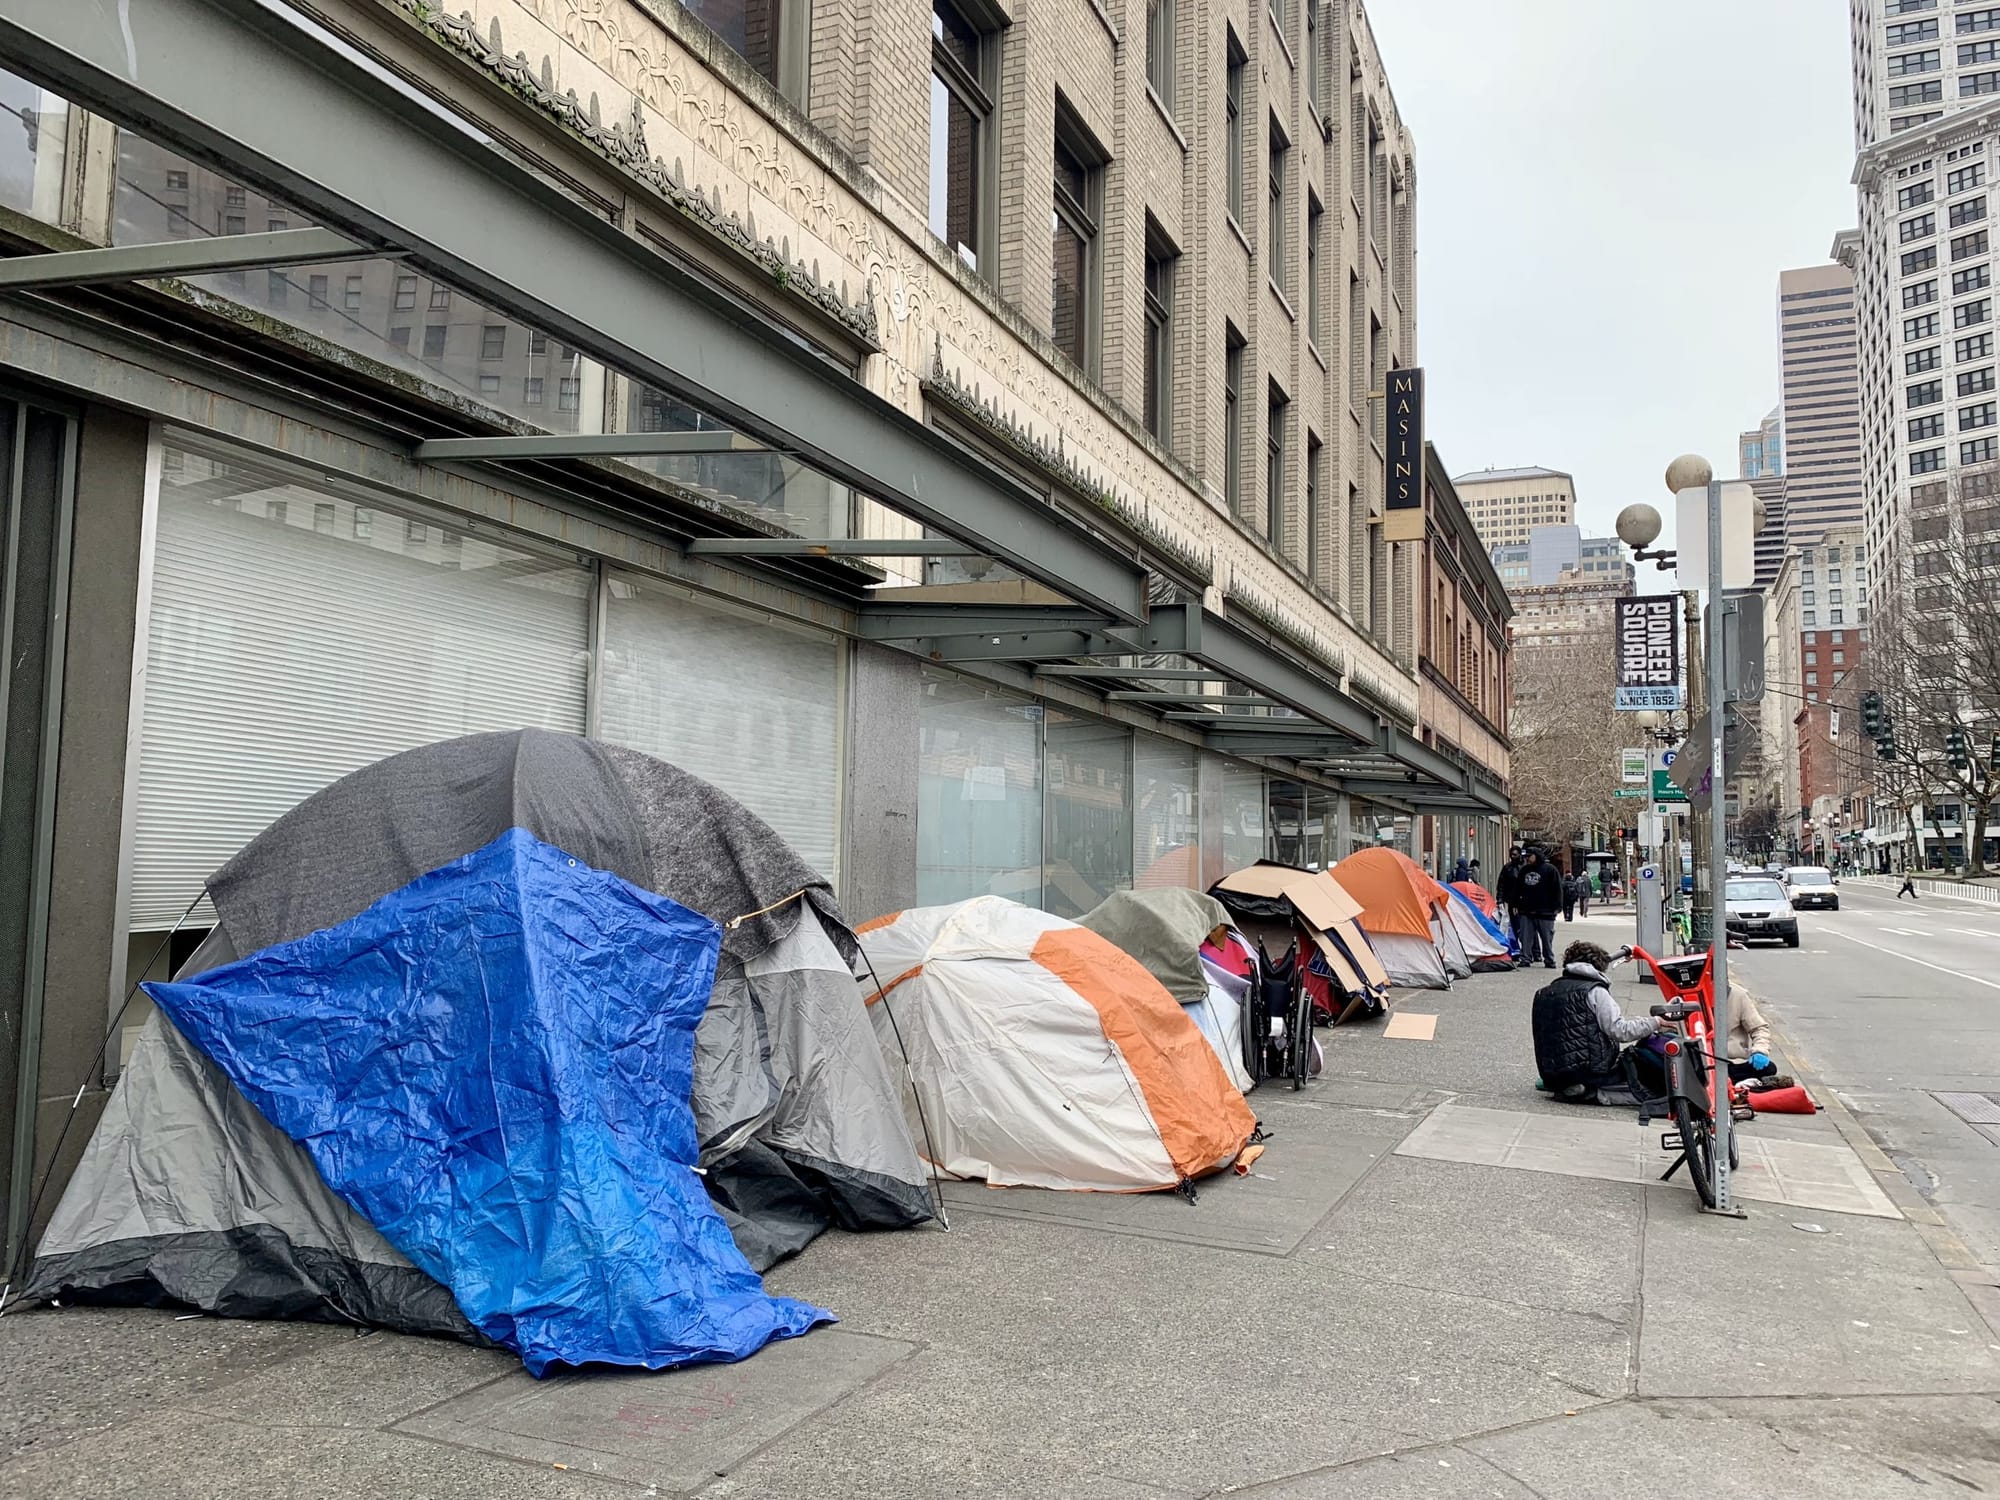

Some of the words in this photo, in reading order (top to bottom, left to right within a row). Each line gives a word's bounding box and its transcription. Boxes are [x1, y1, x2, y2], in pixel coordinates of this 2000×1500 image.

[1394, 377, 1413, 499] MASINS
[1623, 603, 1647, 682] SQUARE
[1647, 602, 1671, 682] PIONEER
[1651, 695, 1675, 706] 1852
